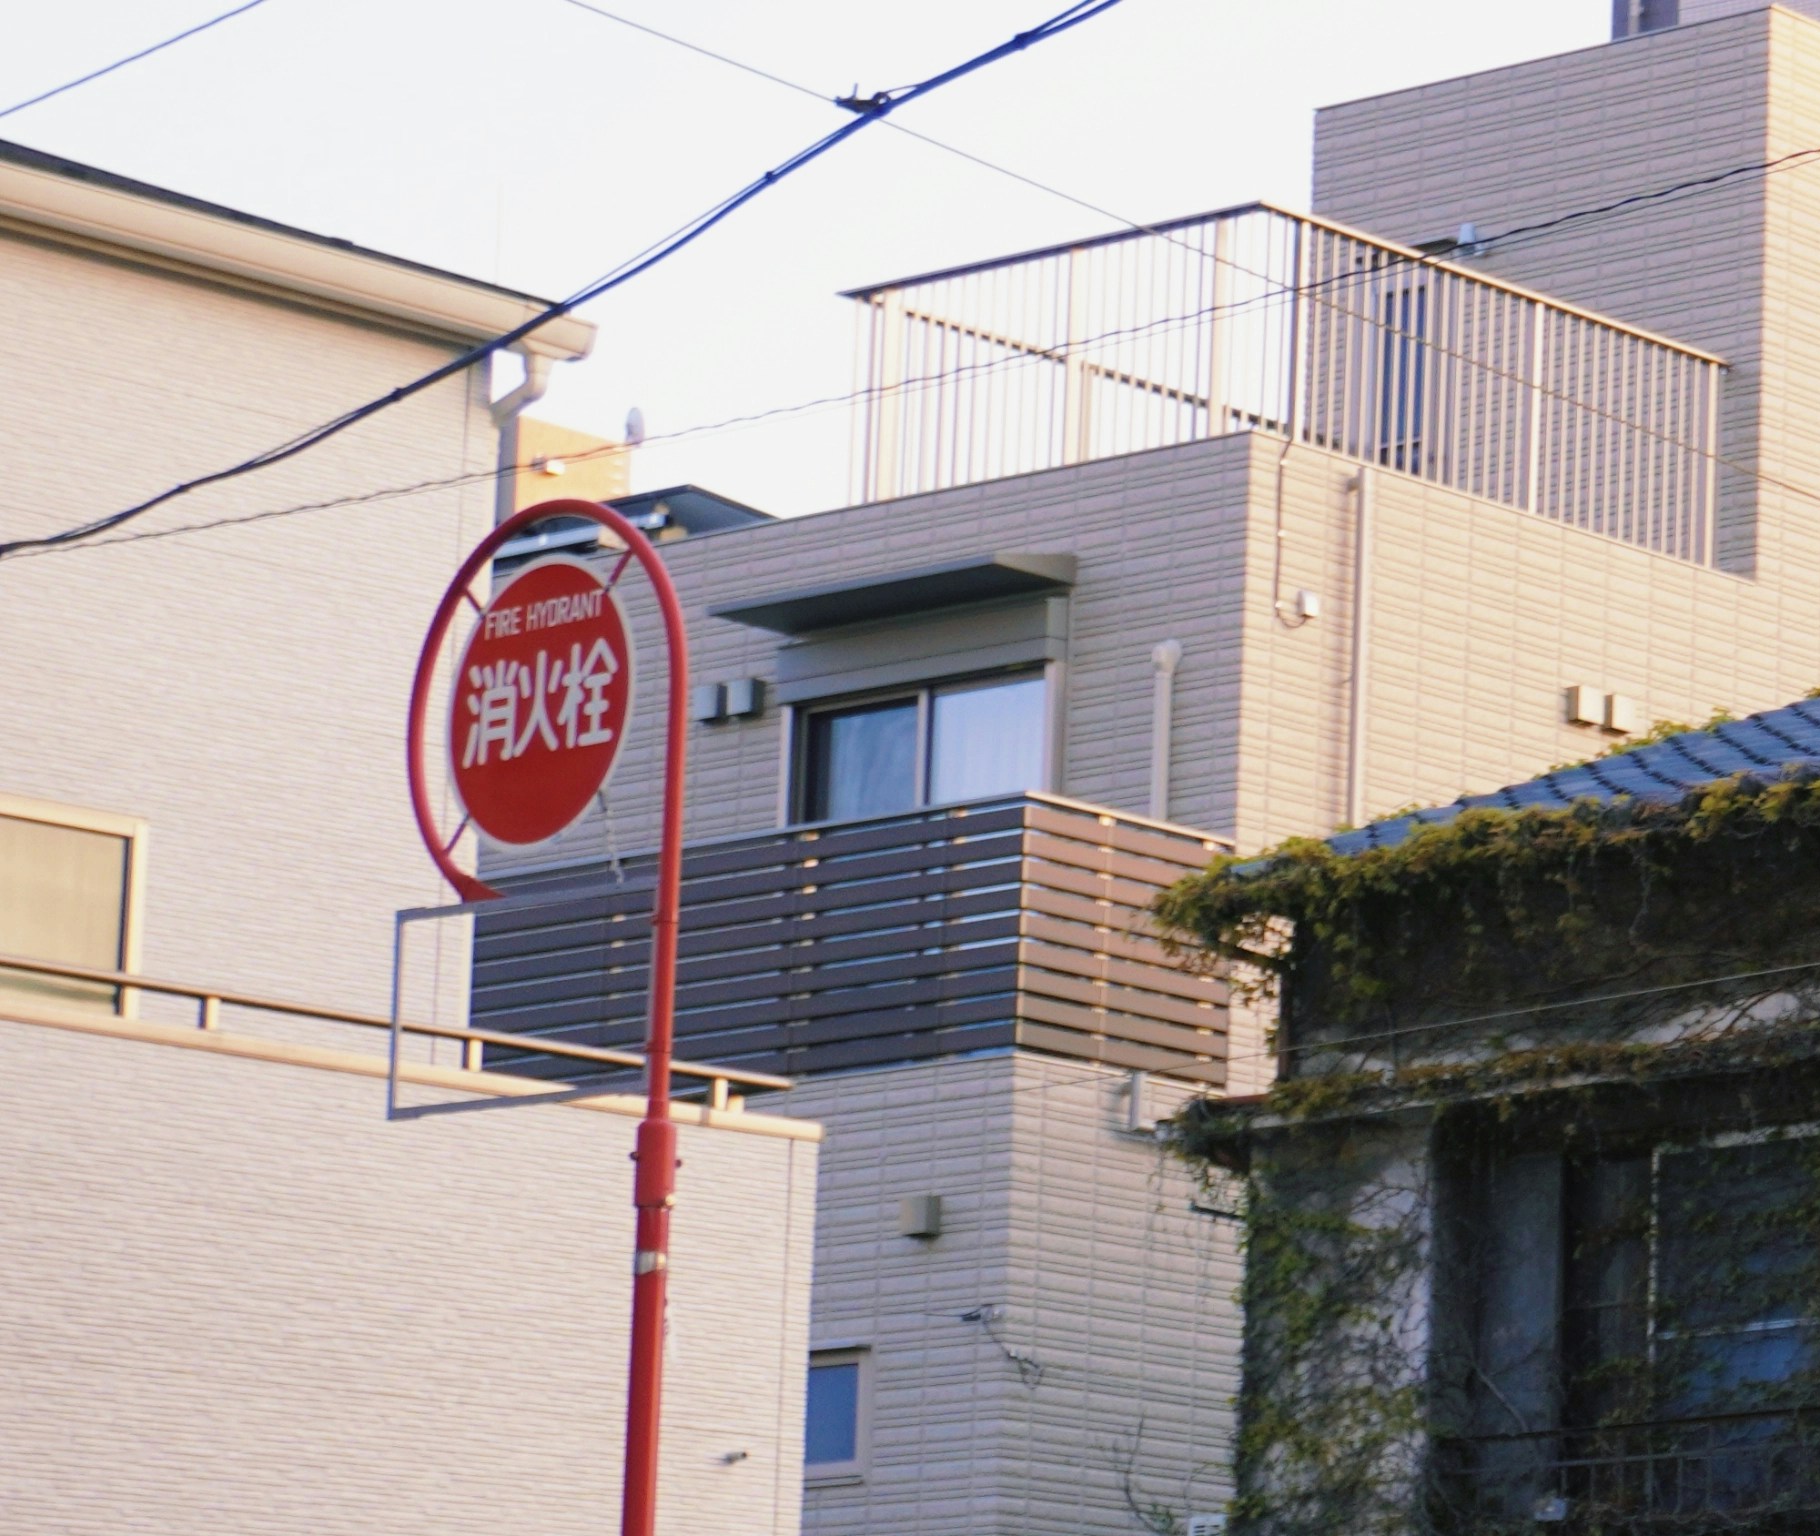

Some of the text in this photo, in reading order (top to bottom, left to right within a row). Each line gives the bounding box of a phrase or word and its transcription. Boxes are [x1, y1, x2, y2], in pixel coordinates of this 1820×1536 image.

[485, 590, 604, 640] FIRE HYDRANT
[462, 637, 618, 769] 消火栓
